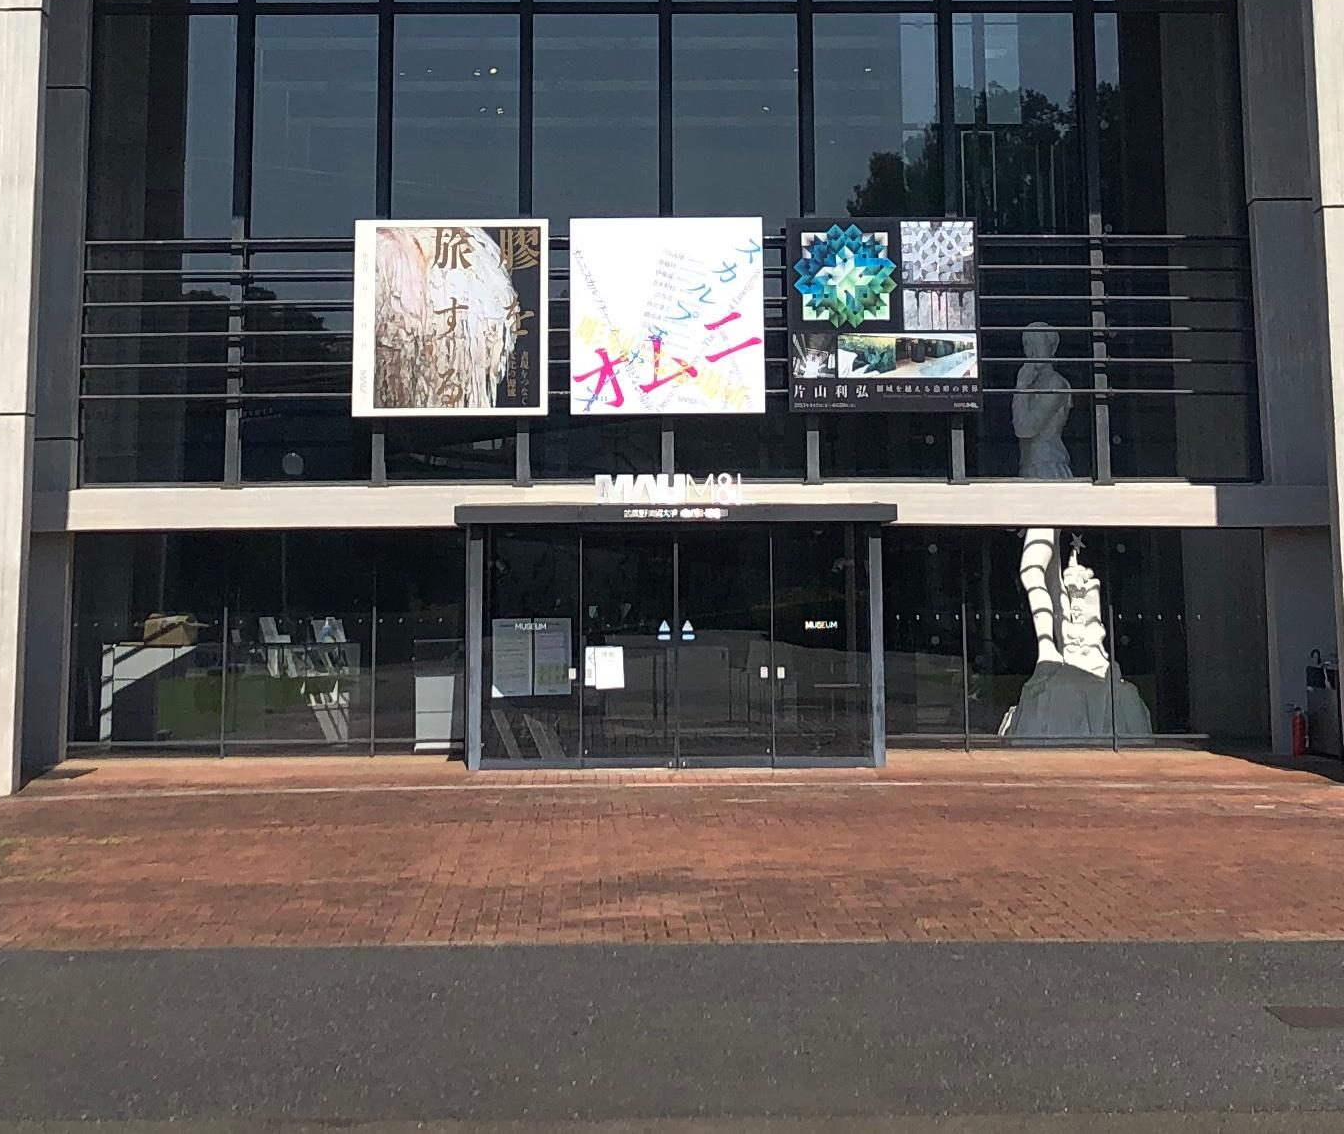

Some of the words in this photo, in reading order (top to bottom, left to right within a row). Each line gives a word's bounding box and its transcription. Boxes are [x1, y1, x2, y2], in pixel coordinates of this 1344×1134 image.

[431, 227, 476, 407] 旅する
[498, 228, 539, 337] 膠を
[793, 384, 869, 399] 片山利弘
